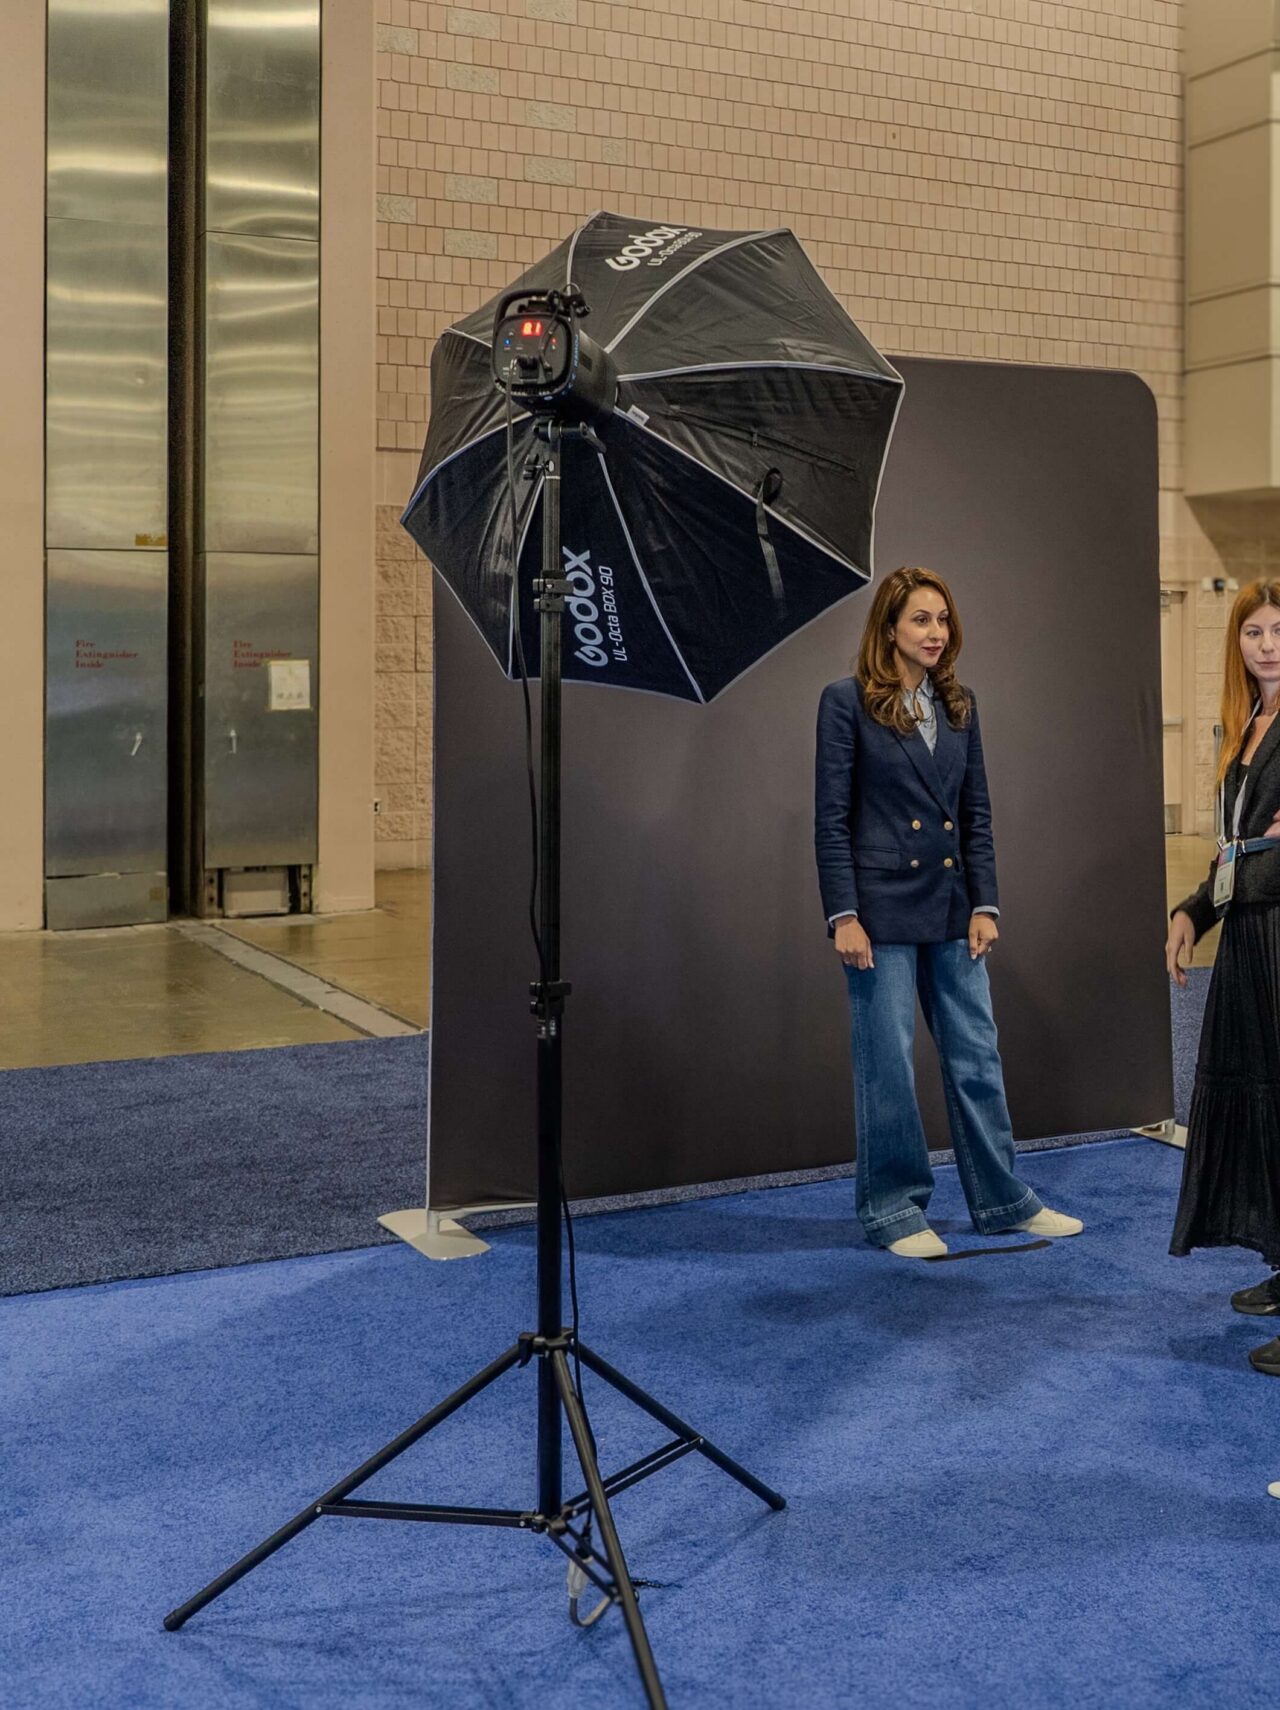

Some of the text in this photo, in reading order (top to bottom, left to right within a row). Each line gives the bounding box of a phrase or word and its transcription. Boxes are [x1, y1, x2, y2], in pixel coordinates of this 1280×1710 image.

[605, 225, 688, 271] Godox
[562, 545, 609, 667] Godox
[598, 565, 628, 662] UL-Octa BOX 90
